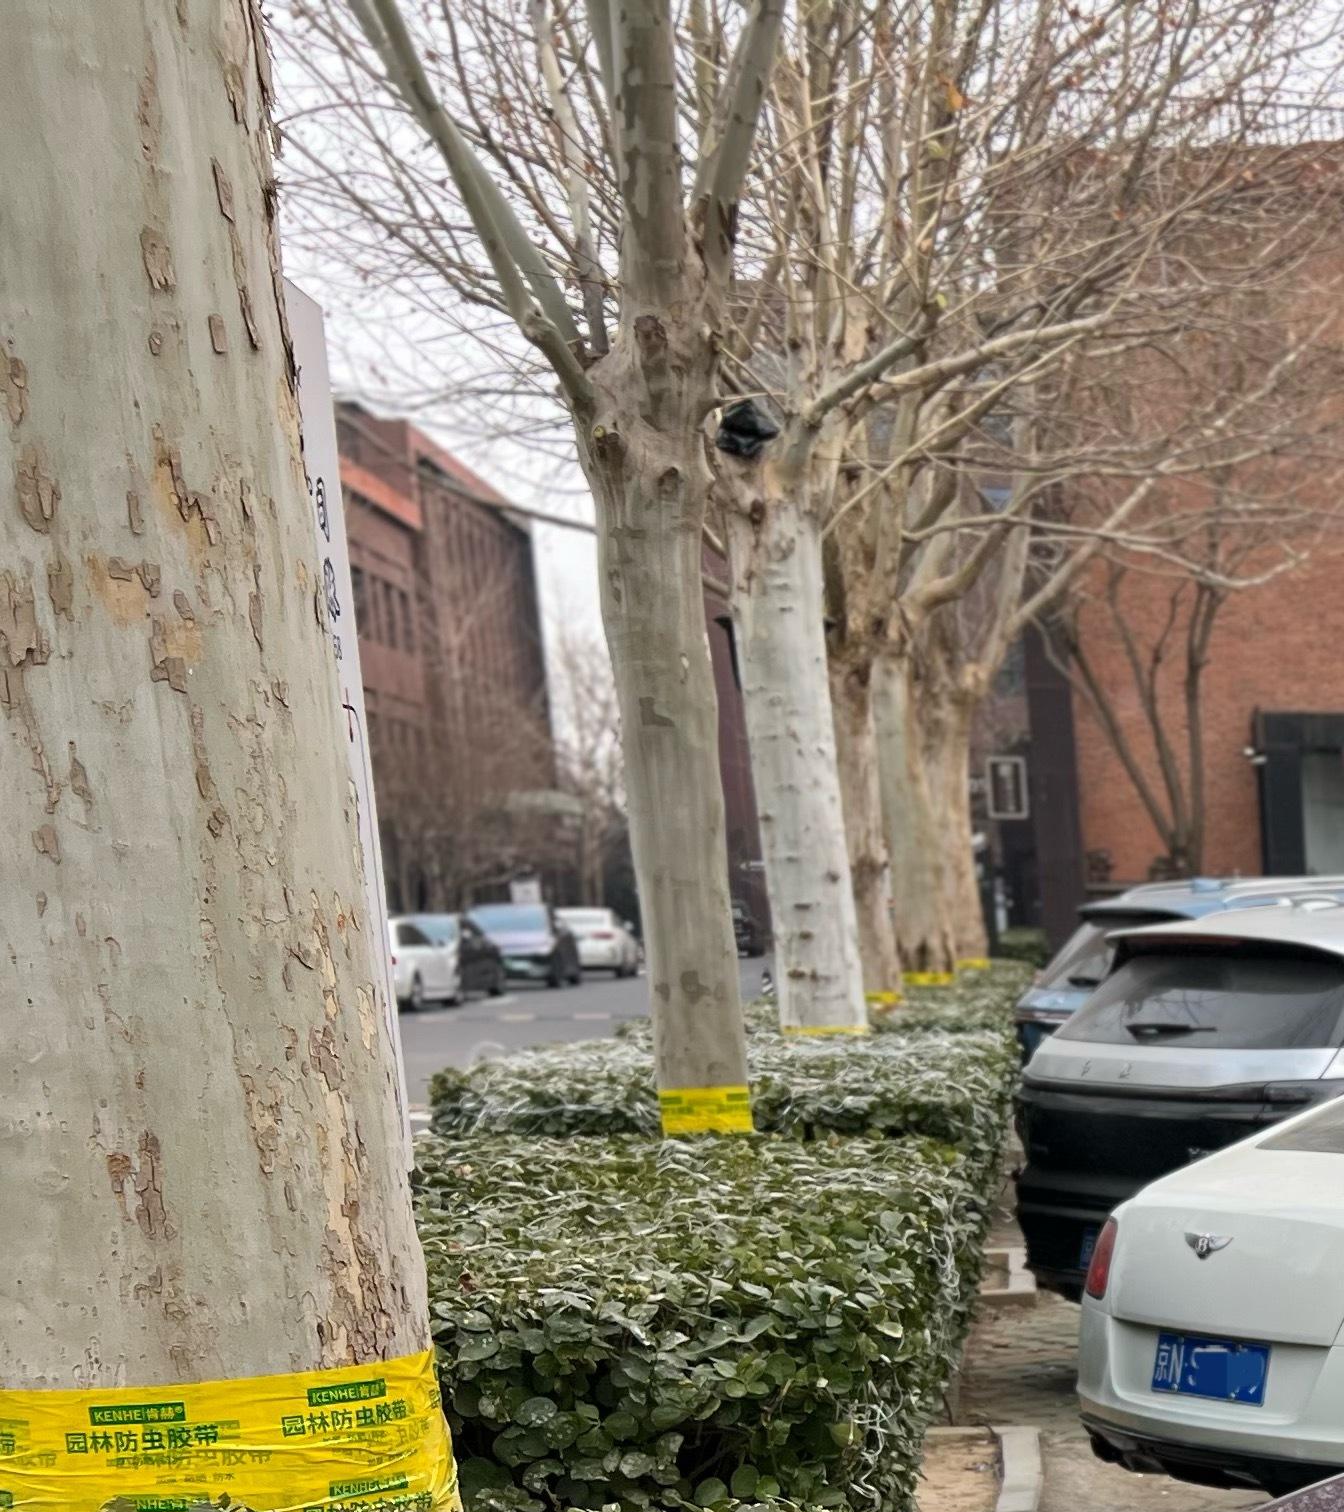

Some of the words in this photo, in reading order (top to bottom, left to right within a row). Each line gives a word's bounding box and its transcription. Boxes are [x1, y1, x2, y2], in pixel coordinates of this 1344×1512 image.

[312, 1388, 356, 1403] KENHE
[93, 1409, 142, 1424] KENHE
[281, 1399, 407, 1437] 园林防虫胶带
[65, 1423, 219, 1454] 园林防虫胶带
